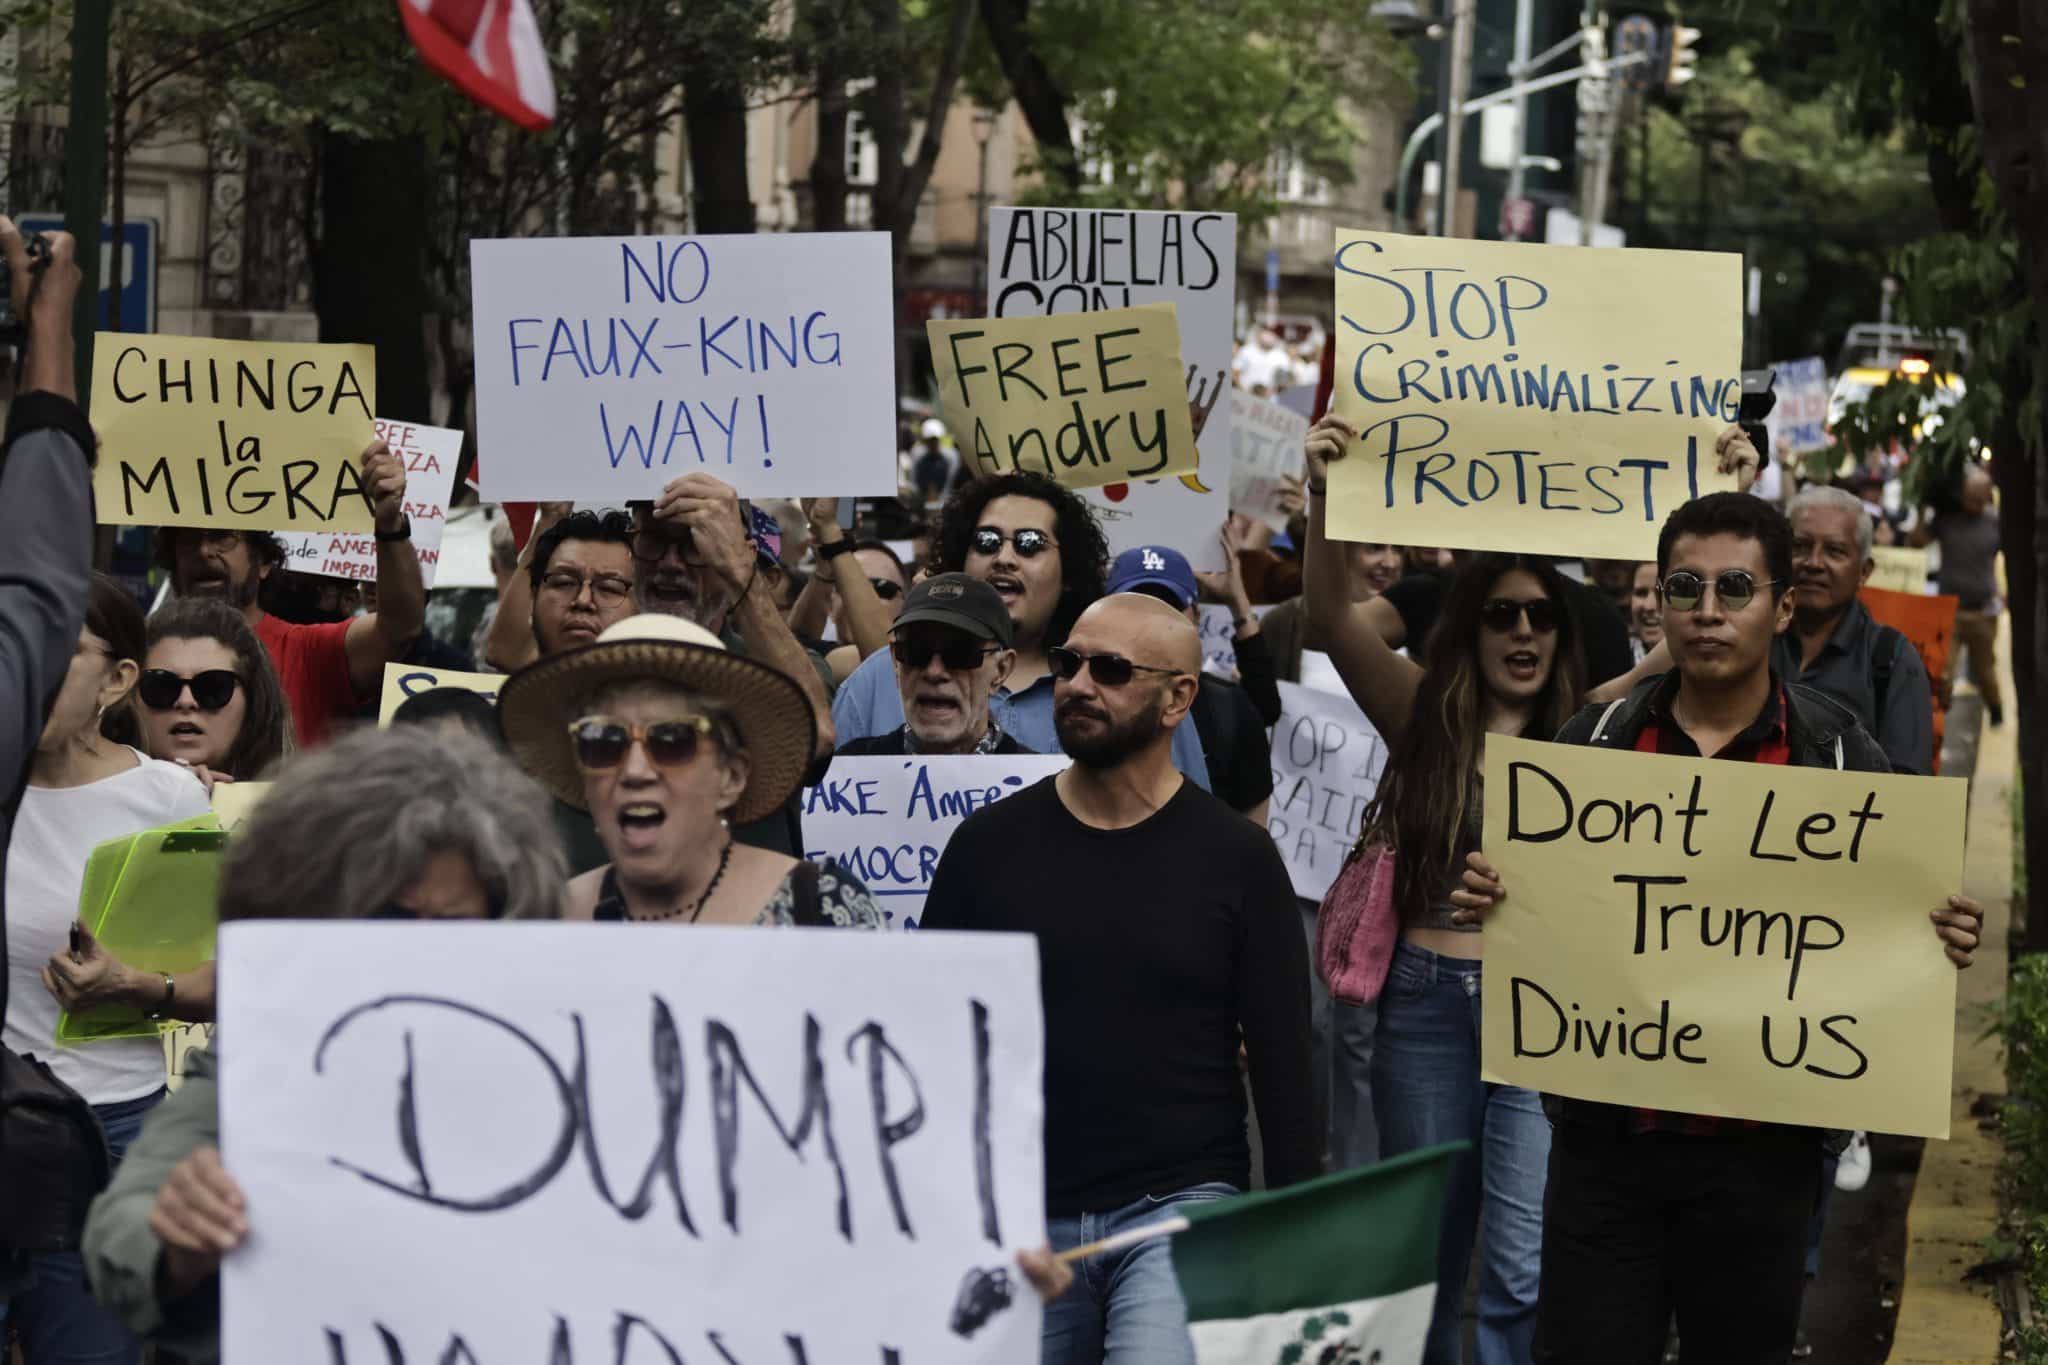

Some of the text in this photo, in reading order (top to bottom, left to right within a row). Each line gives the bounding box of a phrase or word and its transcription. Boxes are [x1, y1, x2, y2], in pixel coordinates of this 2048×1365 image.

[621, 241, 709, 304] NO
[1000, 210, 1223, 290] ABUELAS
[1335, 240, 1548, 346] STOP
[113, 347, 373, 420] CHINGA
[508, 311, 842, 386] FAUX-KING
[949, 328, 1147, 408] FREE
[218, 420, 261, 466] la
[375, 421, 420, 449] REE
[393, 450, 441, 475] AZA
[600, 394, 773, 469] WAY!
[974, 402, 1168, 478] Andry
[1360, 413, 1699, 522] PROTEST!
[120, 456, 376, 521] MIGRA
[403, 501, 445, 520] AZA
[1142, 548, 1165, 570] LA
[1275, 711, 1346, 774] OP
[800, 777, 888, 817] AKE
[1507, 761, 1884, 862] Don't Let
[1613, 874, 1845, 1000] Trump
[1511, 976, 1707, 1065] Divide
[314, 992, 1015, 1340] DUMP!
